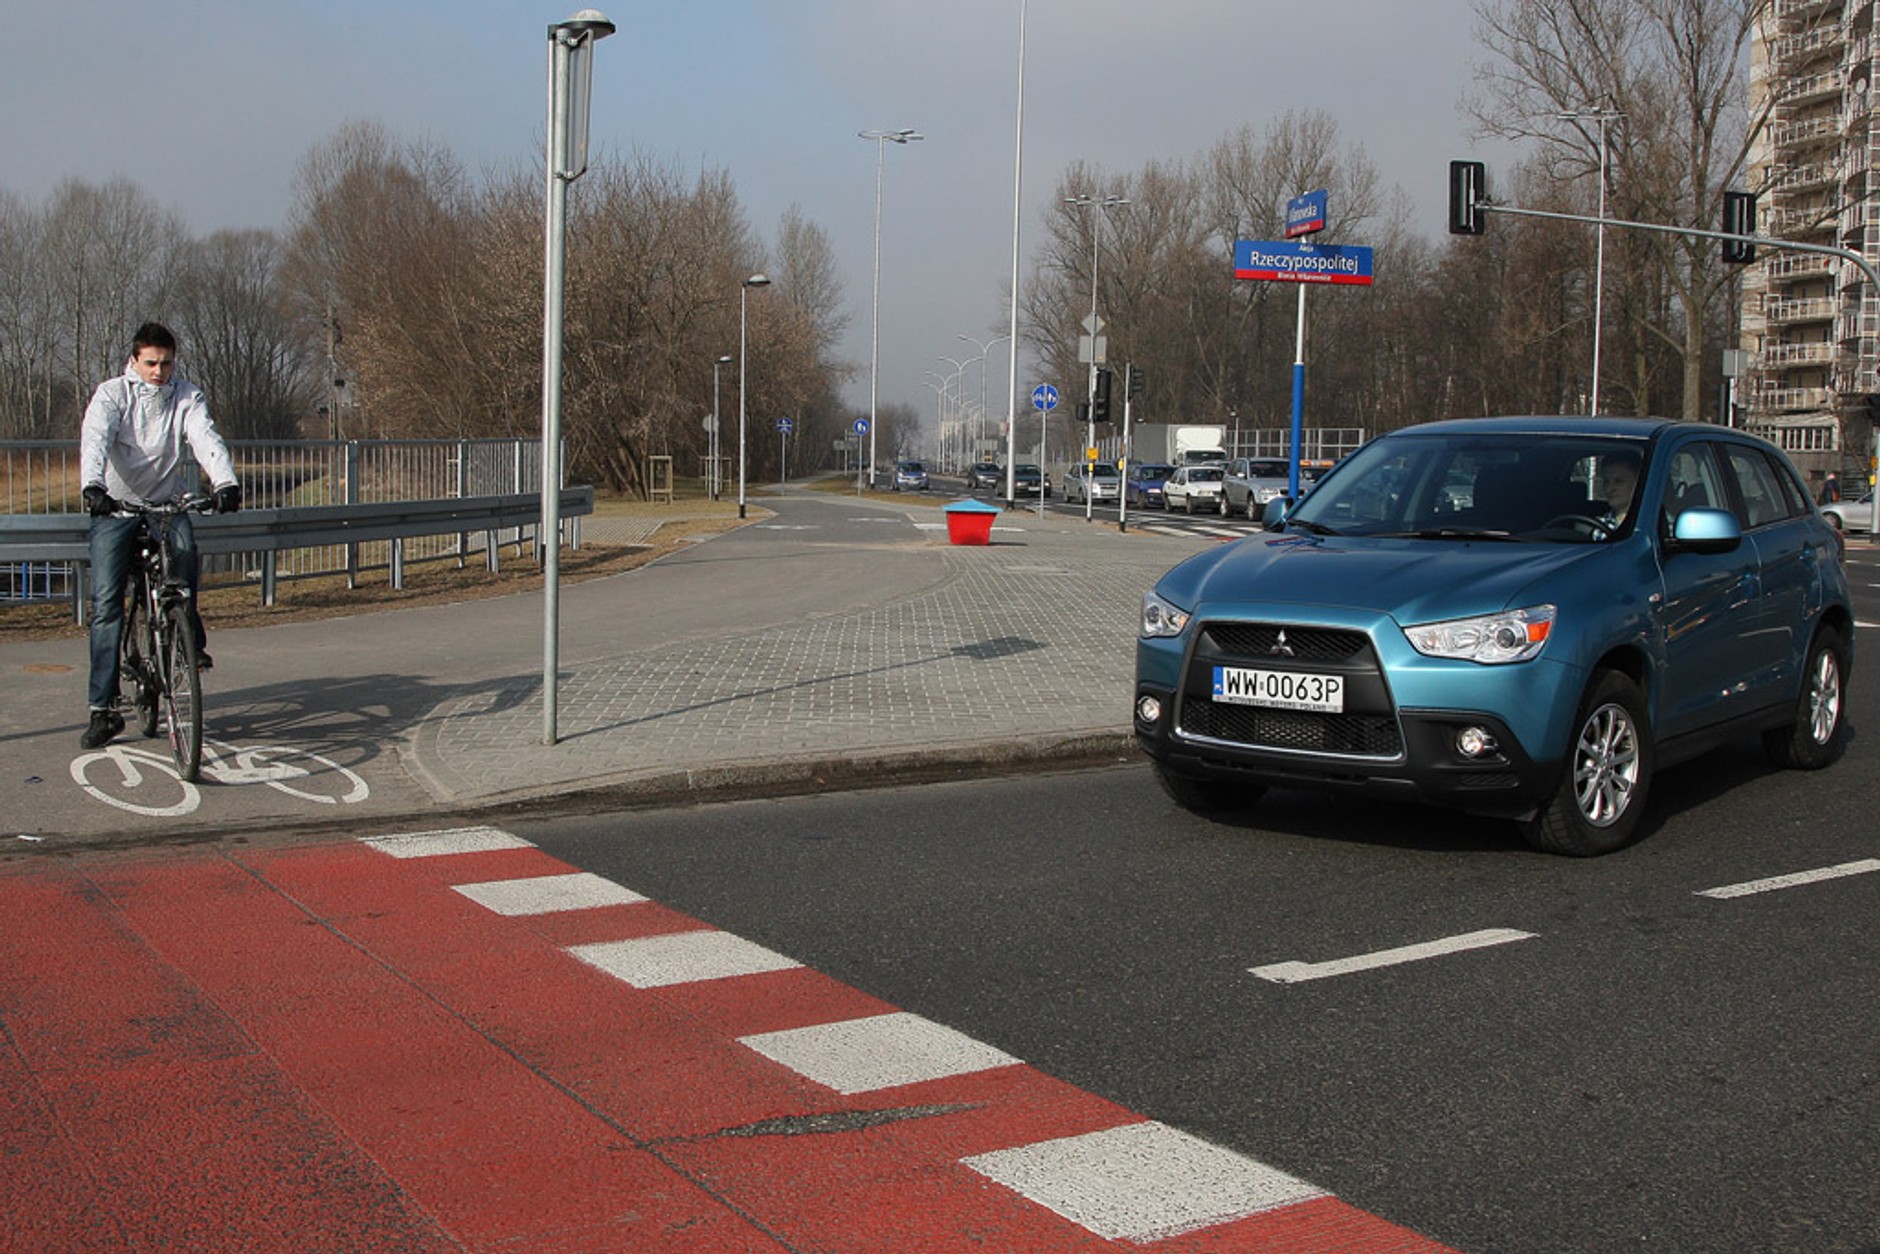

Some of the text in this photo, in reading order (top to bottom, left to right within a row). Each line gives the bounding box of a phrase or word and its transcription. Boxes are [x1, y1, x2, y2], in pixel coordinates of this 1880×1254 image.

[1250, 251, 1358, 275] Rzeczypospolitej
[1226, 670, 1340, 703] WW 0063P
